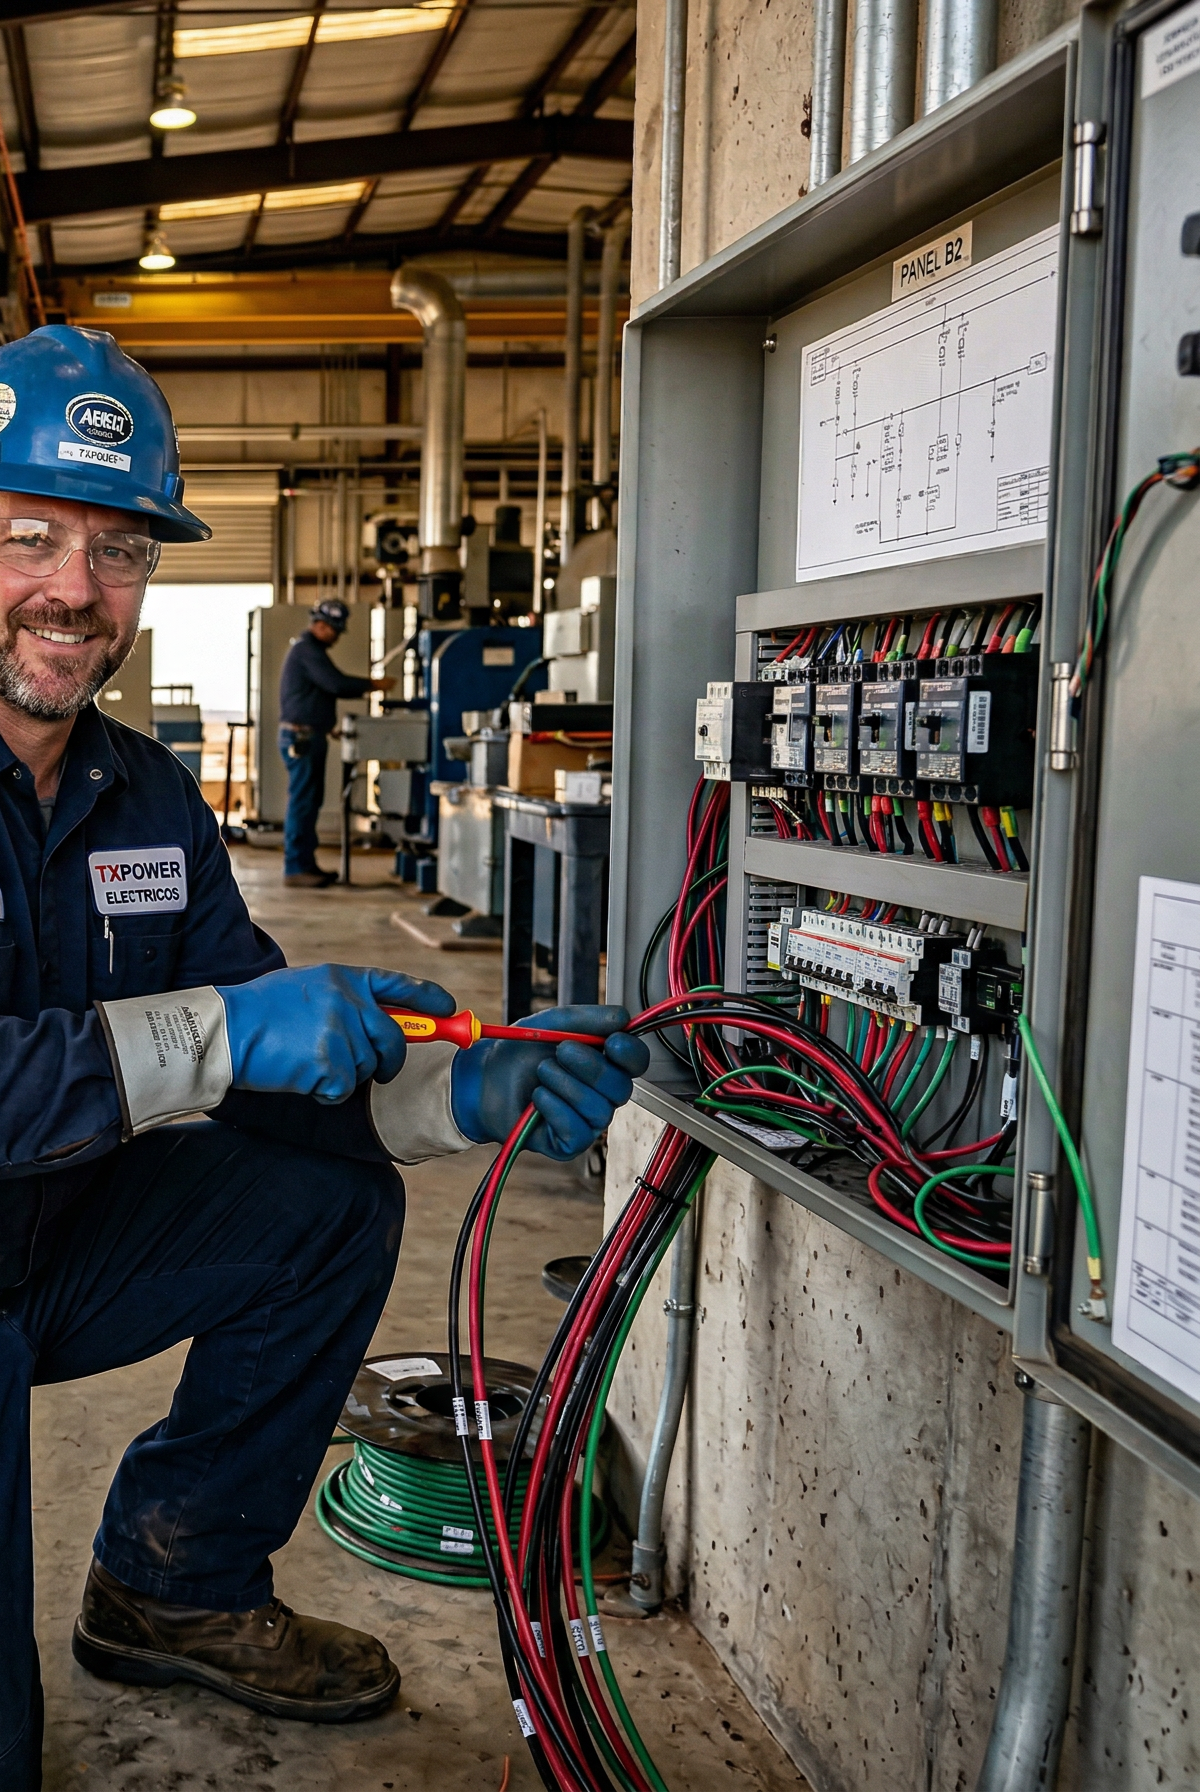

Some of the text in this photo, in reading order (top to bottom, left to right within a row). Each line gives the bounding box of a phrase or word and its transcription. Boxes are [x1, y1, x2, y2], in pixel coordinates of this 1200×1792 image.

[900, 237, 963, 288] PANEL B2
[94, 861, 182, 883] TXPOWER
[105, 887, 180, 905] ELECTRICOS
